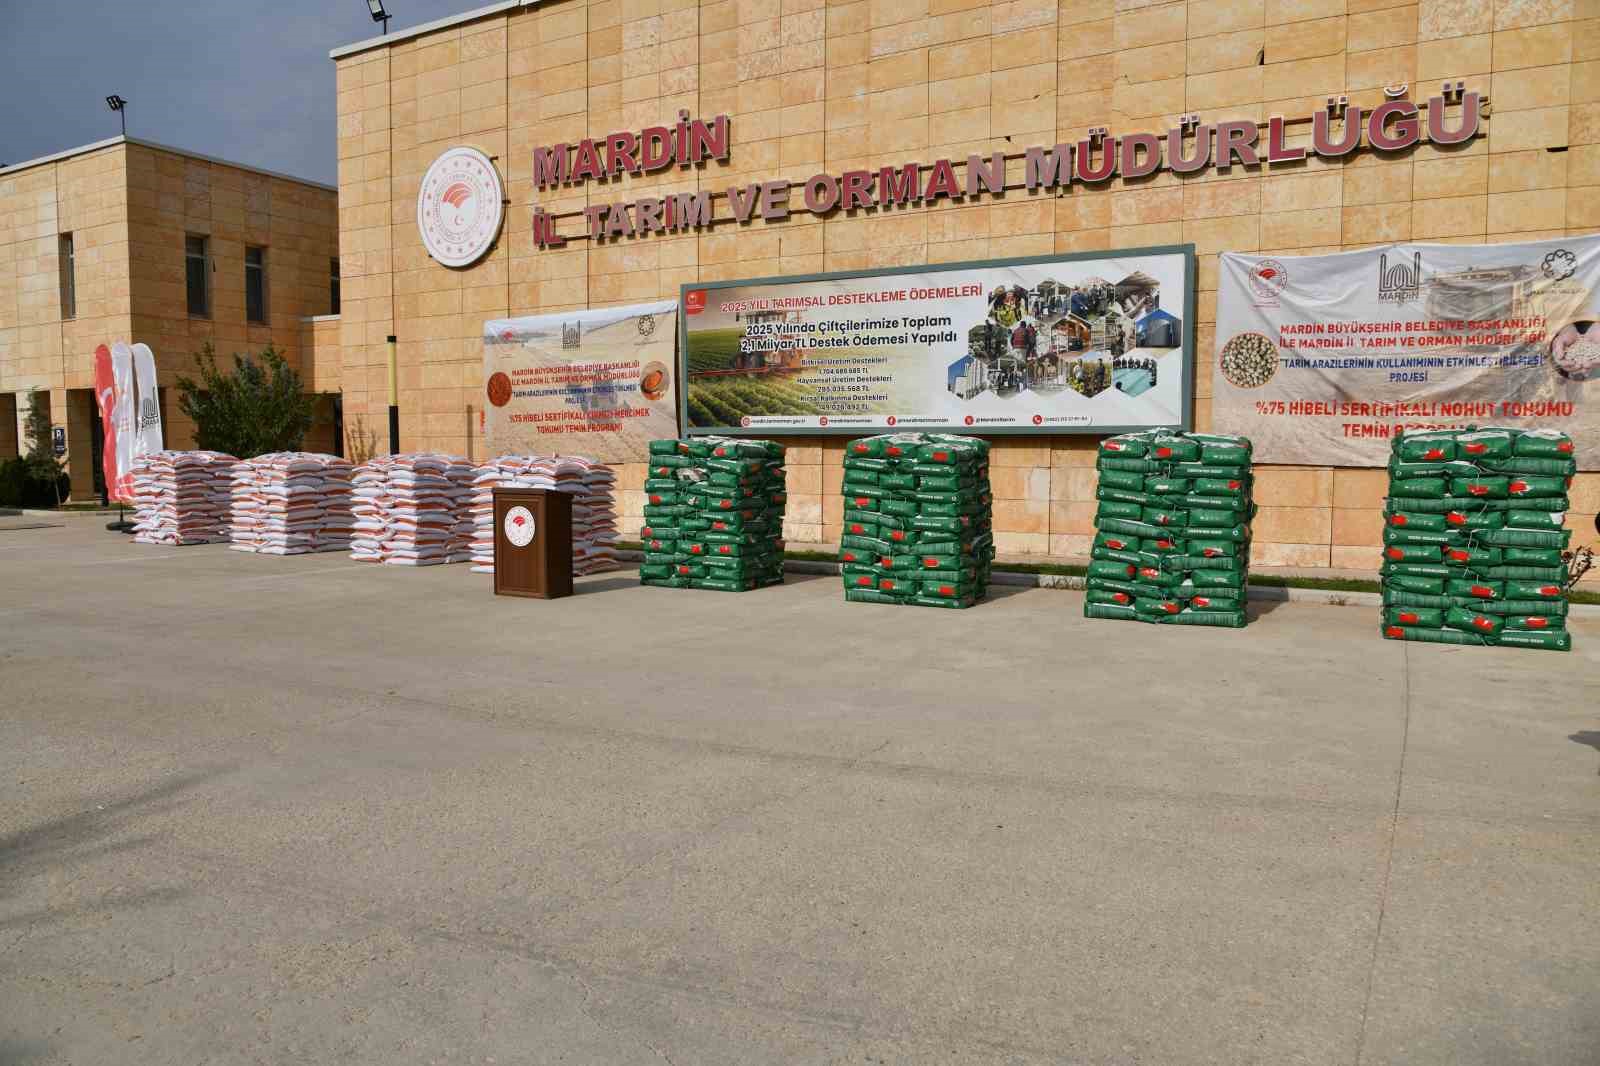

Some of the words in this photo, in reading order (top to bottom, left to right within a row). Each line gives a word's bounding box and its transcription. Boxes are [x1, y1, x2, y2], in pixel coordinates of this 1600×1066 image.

[533, 109, 729, 187] MARDİN
[533, 206, 563, 246] İL
[584, 191, 713, 239] TARIM
[727, 180, 791, 224] VE
[804, 152, 1006, 214] ORMAN
[1025, 81, 1481, 188] MÜDÜRLÜĞÜ
[720, 302, 747, 312] 2025
[750, 298, 769, 310] YILI
[773, 295, 827, 309] TARIMSAL
[829, 290, 907, 306] DESTEKLEME
[909, 285, 984, 301] ÖDEMELERİ
[746, 324, 773, 336] 2025
[776, 322, 815, 334] Yılında
[818, 317, 899, 335] Çiftçilerimize
[902, 315, 951, 330] Toplam
[1280, 323, 1324, 334] MARDİN
[1327, 321, 1401, 335] BÜYÜKŞEHİR
[758, 338, 793, 352] Milyar
[794, 337, 808, 348] TL
[810, 334, 850, 347] Destek
[852, 331, 909, 346] Ödemesi
[912, 330, 957, 345] Yapıldı
[1298, 338, 1343, 348] MARDİN
[1359, 337, 1397, 348] TARIM
[1400, 336, 1415, 347] VE
[1417, 335, 1463, 347] ORMAN
[1390, 370, 1428, 382] PROJESİ
[1255, 400, 1285, 415] %75
[1289, 398, 1337, 415] HİBELİ
[1441, 400, 1497, 416] NOHUT
[1502, 401, 1574, 416] TOHUMU
[1343, 421, 1390, 438] TEMİN
